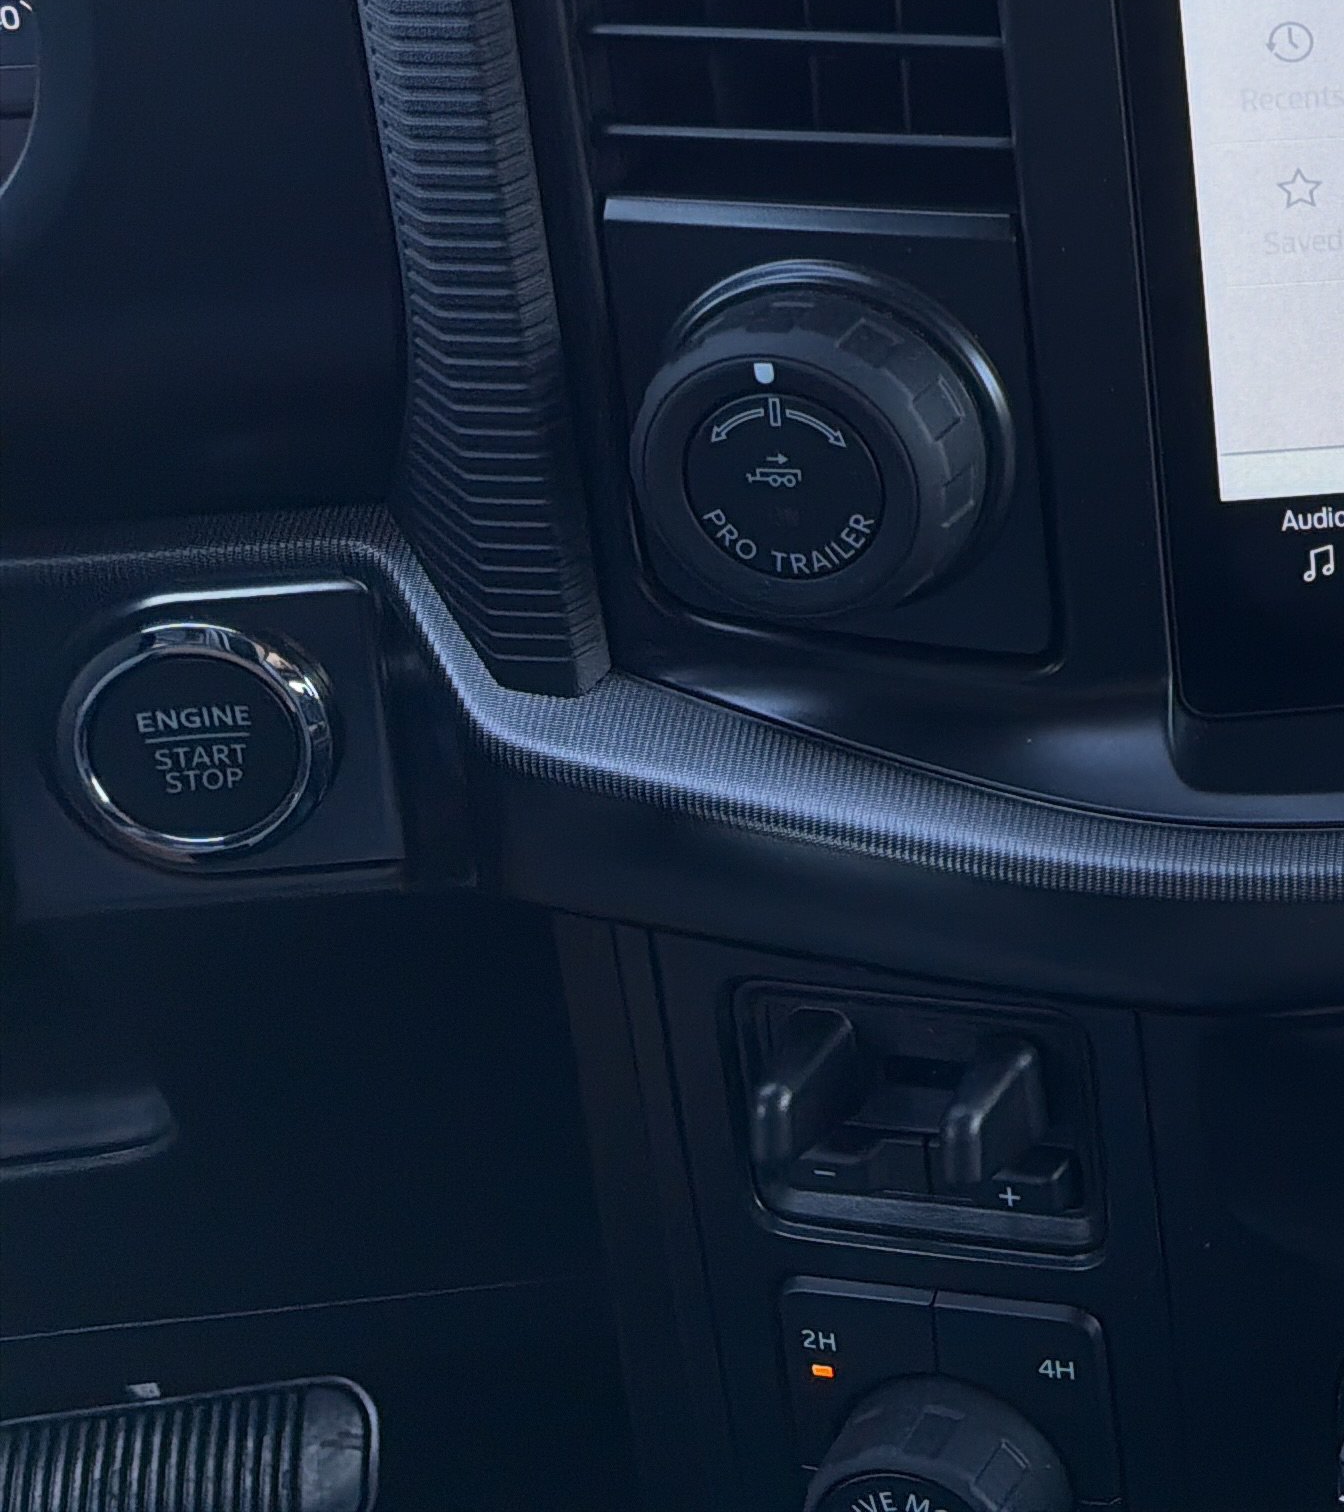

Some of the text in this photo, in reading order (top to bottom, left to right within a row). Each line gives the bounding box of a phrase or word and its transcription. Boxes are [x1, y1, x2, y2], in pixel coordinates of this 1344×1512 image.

[1240, 87, 1344, 112] Recents
[1264, 228, 1343, 256] Saved
[702, 508, 876, 574] PRO TRAILER
[135, 704, 252, 734] ENGINE
[154, 744, 248, 770] START
[164, 767, 244, 795] STOP
[801, 1329, 837, 1353] 2H
[1037, 1358, 1076, 1381] 4H
